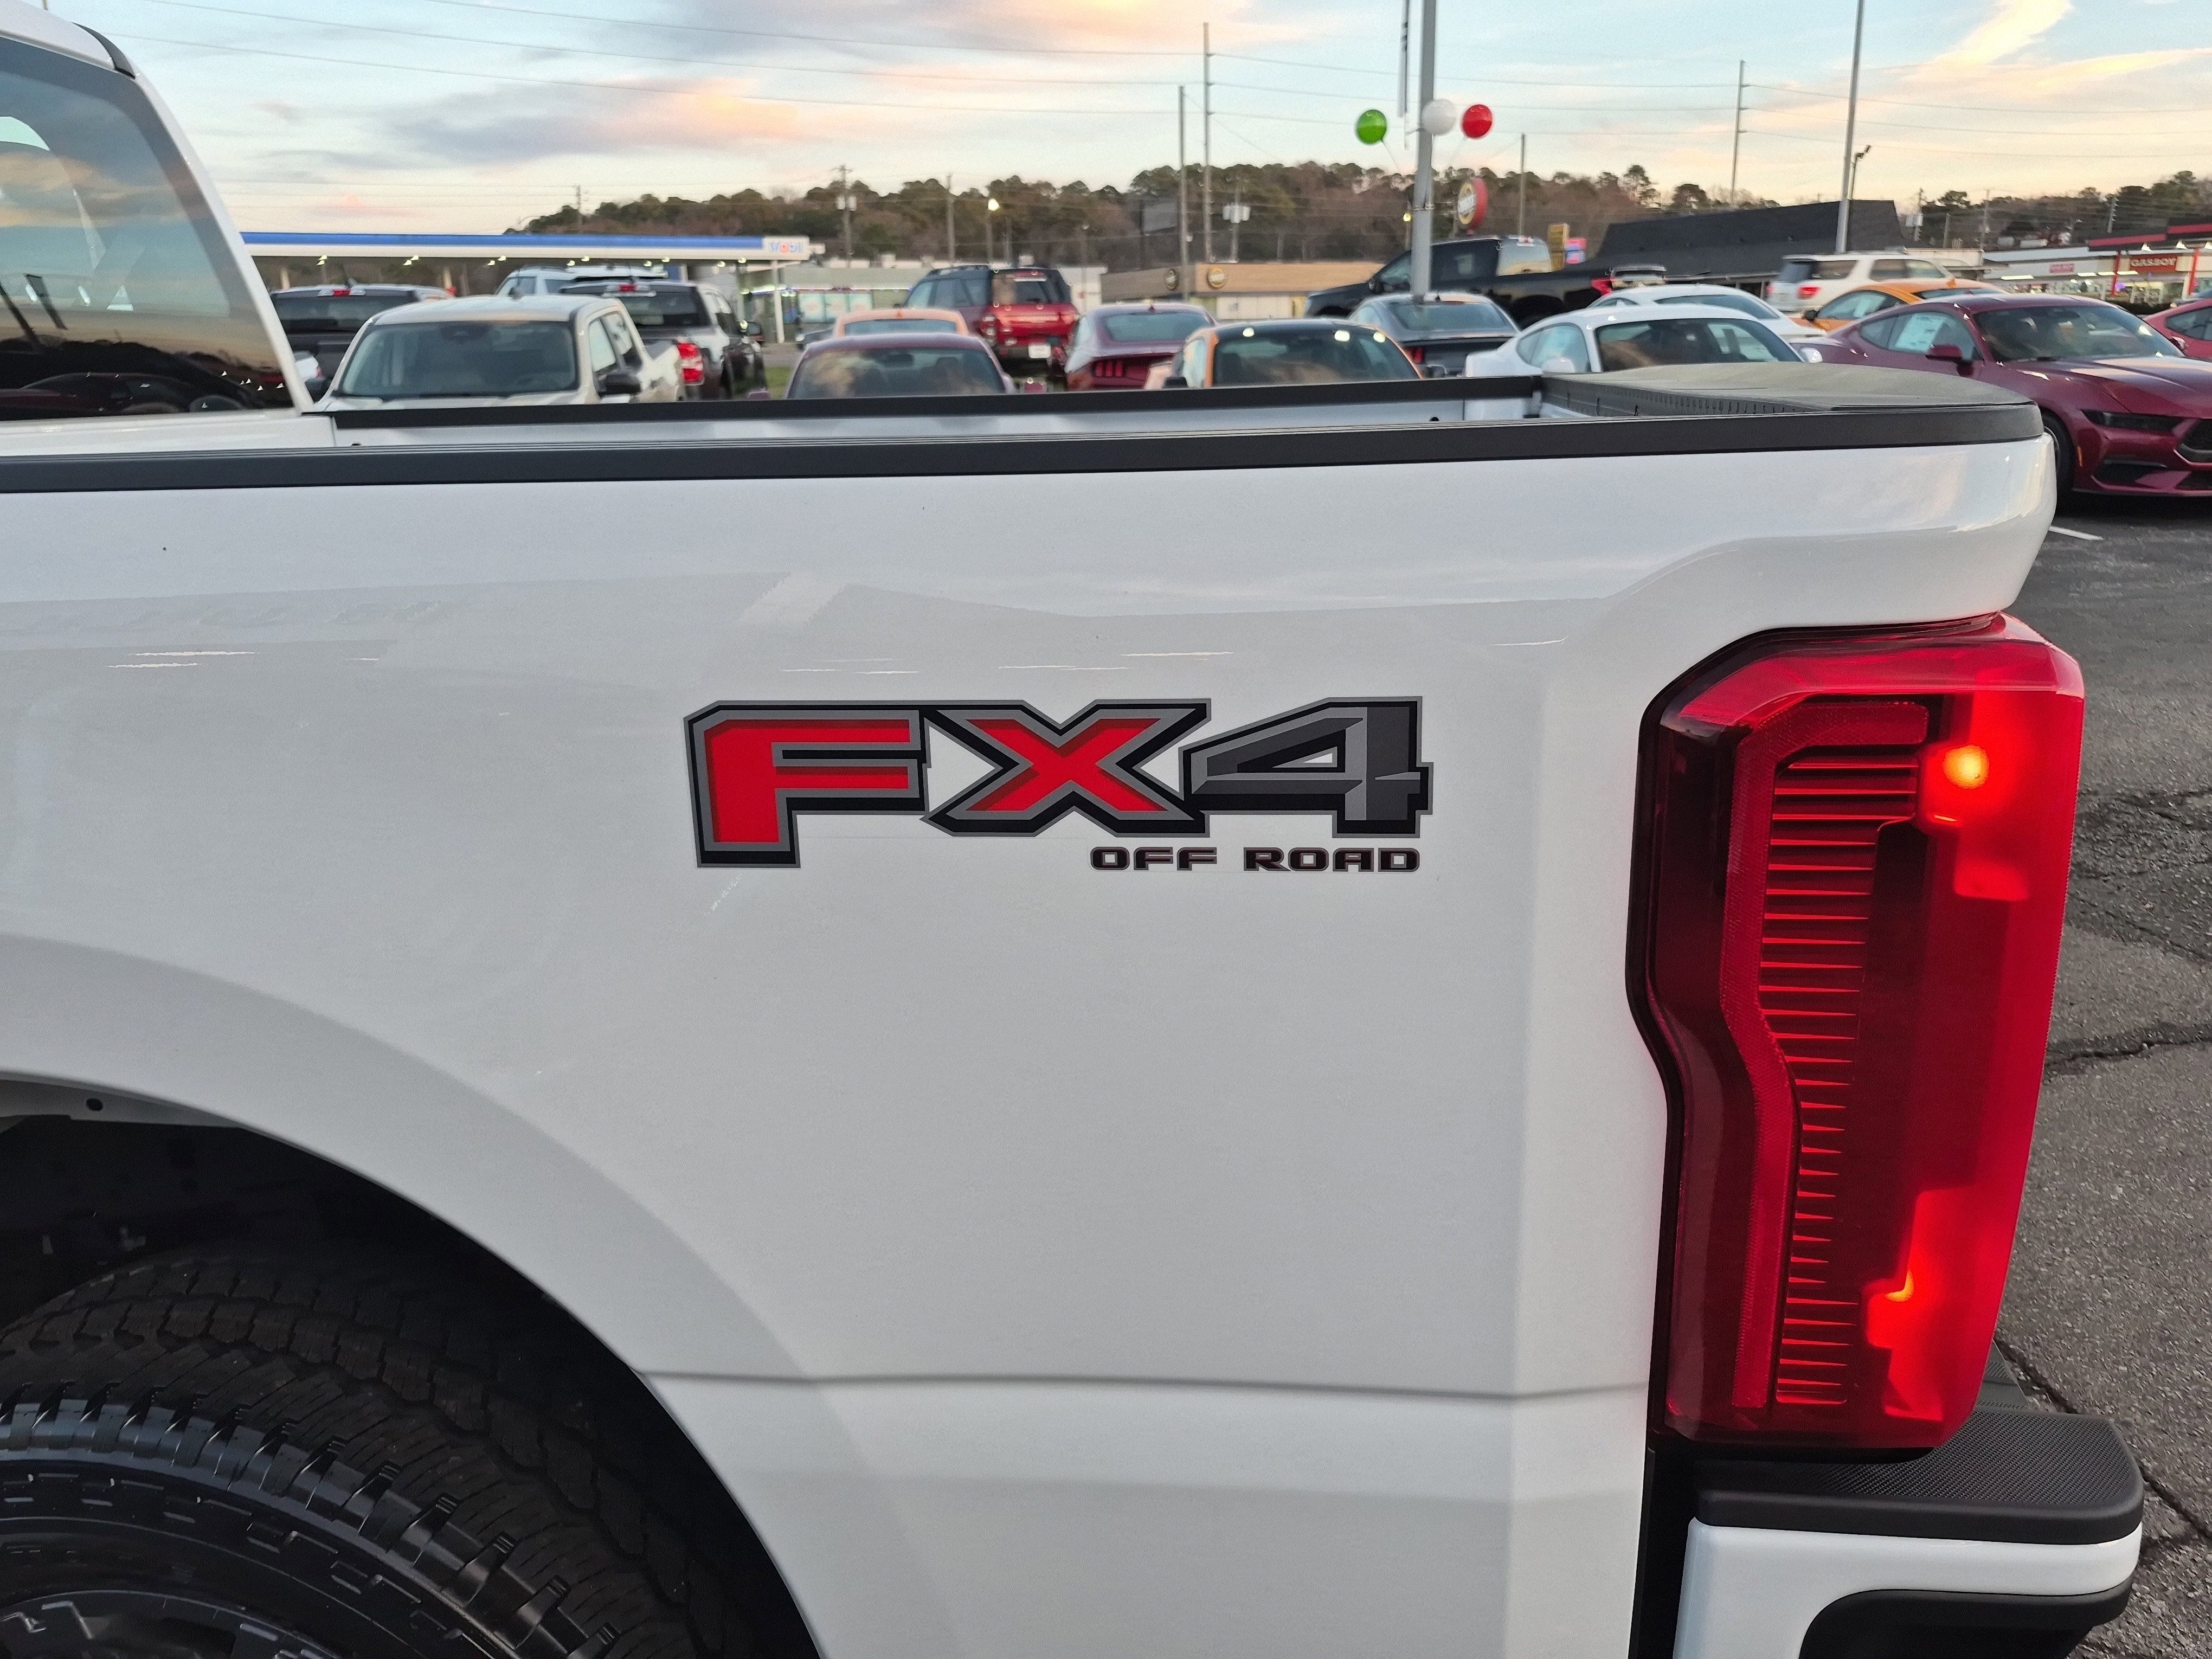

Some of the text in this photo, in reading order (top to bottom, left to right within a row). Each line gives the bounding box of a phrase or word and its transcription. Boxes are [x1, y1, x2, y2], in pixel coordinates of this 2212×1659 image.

[683, 696, 1433, 868] FX4
[1090, 846, 1420, 872] OFF ROAD
